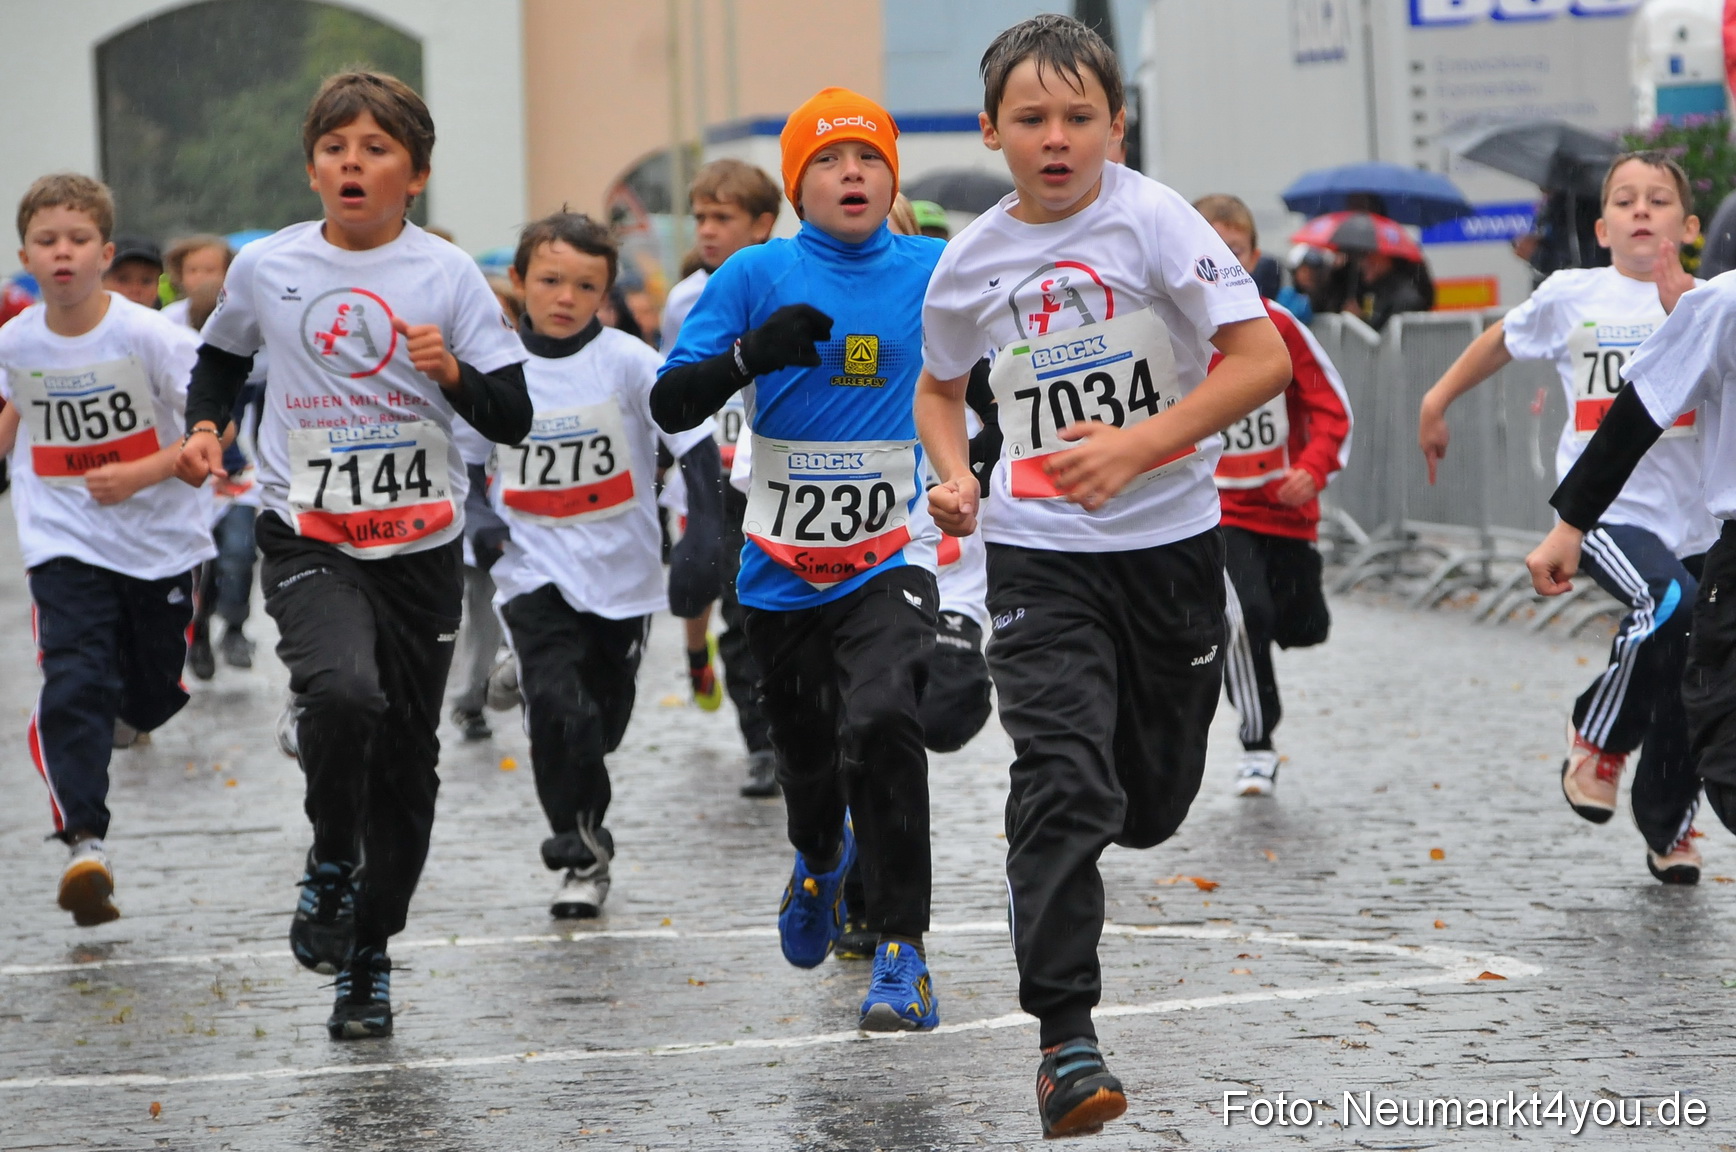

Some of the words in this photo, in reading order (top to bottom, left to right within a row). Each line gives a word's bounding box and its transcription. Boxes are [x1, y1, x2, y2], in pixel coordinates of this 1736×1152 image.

[833, 116, 877, 131] odlo
[1597, 324, 1654, 339] BOCK
[1032, 335, 1107, 369] BOCK
[44, 371, 97, 389] BOCK
[1584, 350, 1636, 393] 70
[832, 376, 886, 387] FIREFLY
[285, 394, 342, 409] LAUFEN
[350, 394, 379, 406] MIT
[1014, 358, 1160, 449] 7034
[32, 391, 137, 441] 7058
[317, 416, 347, 428] Heck
[329, 424, 400, 444] BOCK
[510, 435, 615, 486] 7273
[788, 452, 864, 470] BOCK
[1013, 446, 1021, 457] 4
[308, 449, 432, 508] 7144
[767, 480, 896, 541] 7230
[791, 551, 857, 574] Simon
[1191, 651, 1215, 667] JAKO
